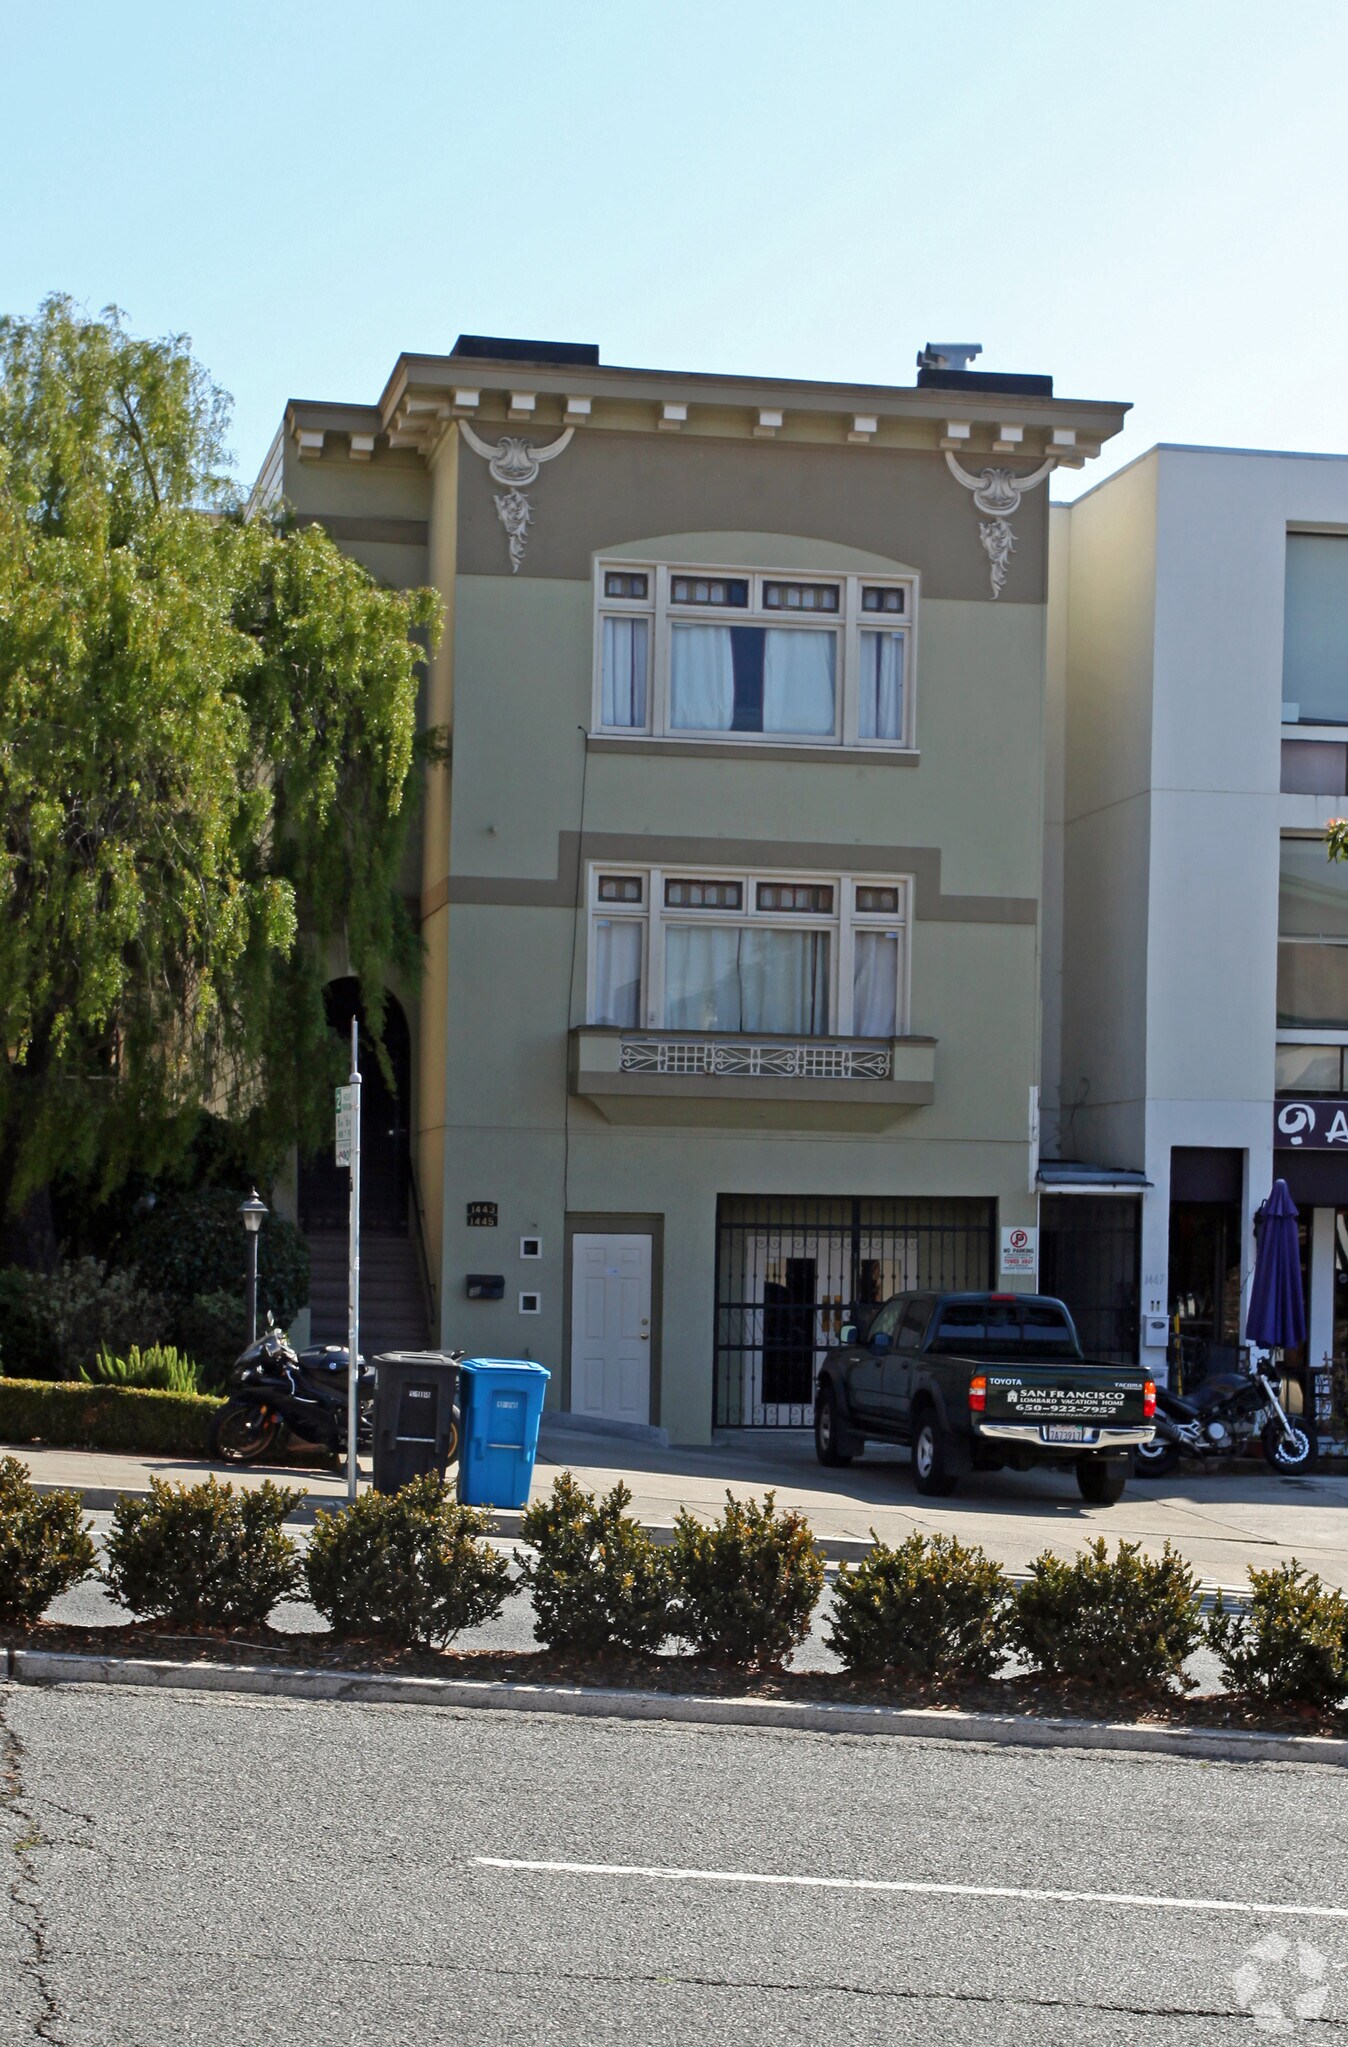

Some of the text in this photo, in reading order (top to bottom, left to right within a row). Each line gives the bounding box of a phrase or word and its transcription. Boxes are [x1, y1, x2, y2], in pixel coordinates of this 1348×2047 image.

[471, 1205, 495, 1214] 1443
[470, 1217, 494, 1226] 1445
[989, 1377, 1022, 1386] TOYOTA
[1020, 1389, 1125, 1400] SAN FRANCISCO
[1015, 1404, 1117, 1414] 650-922-7952
